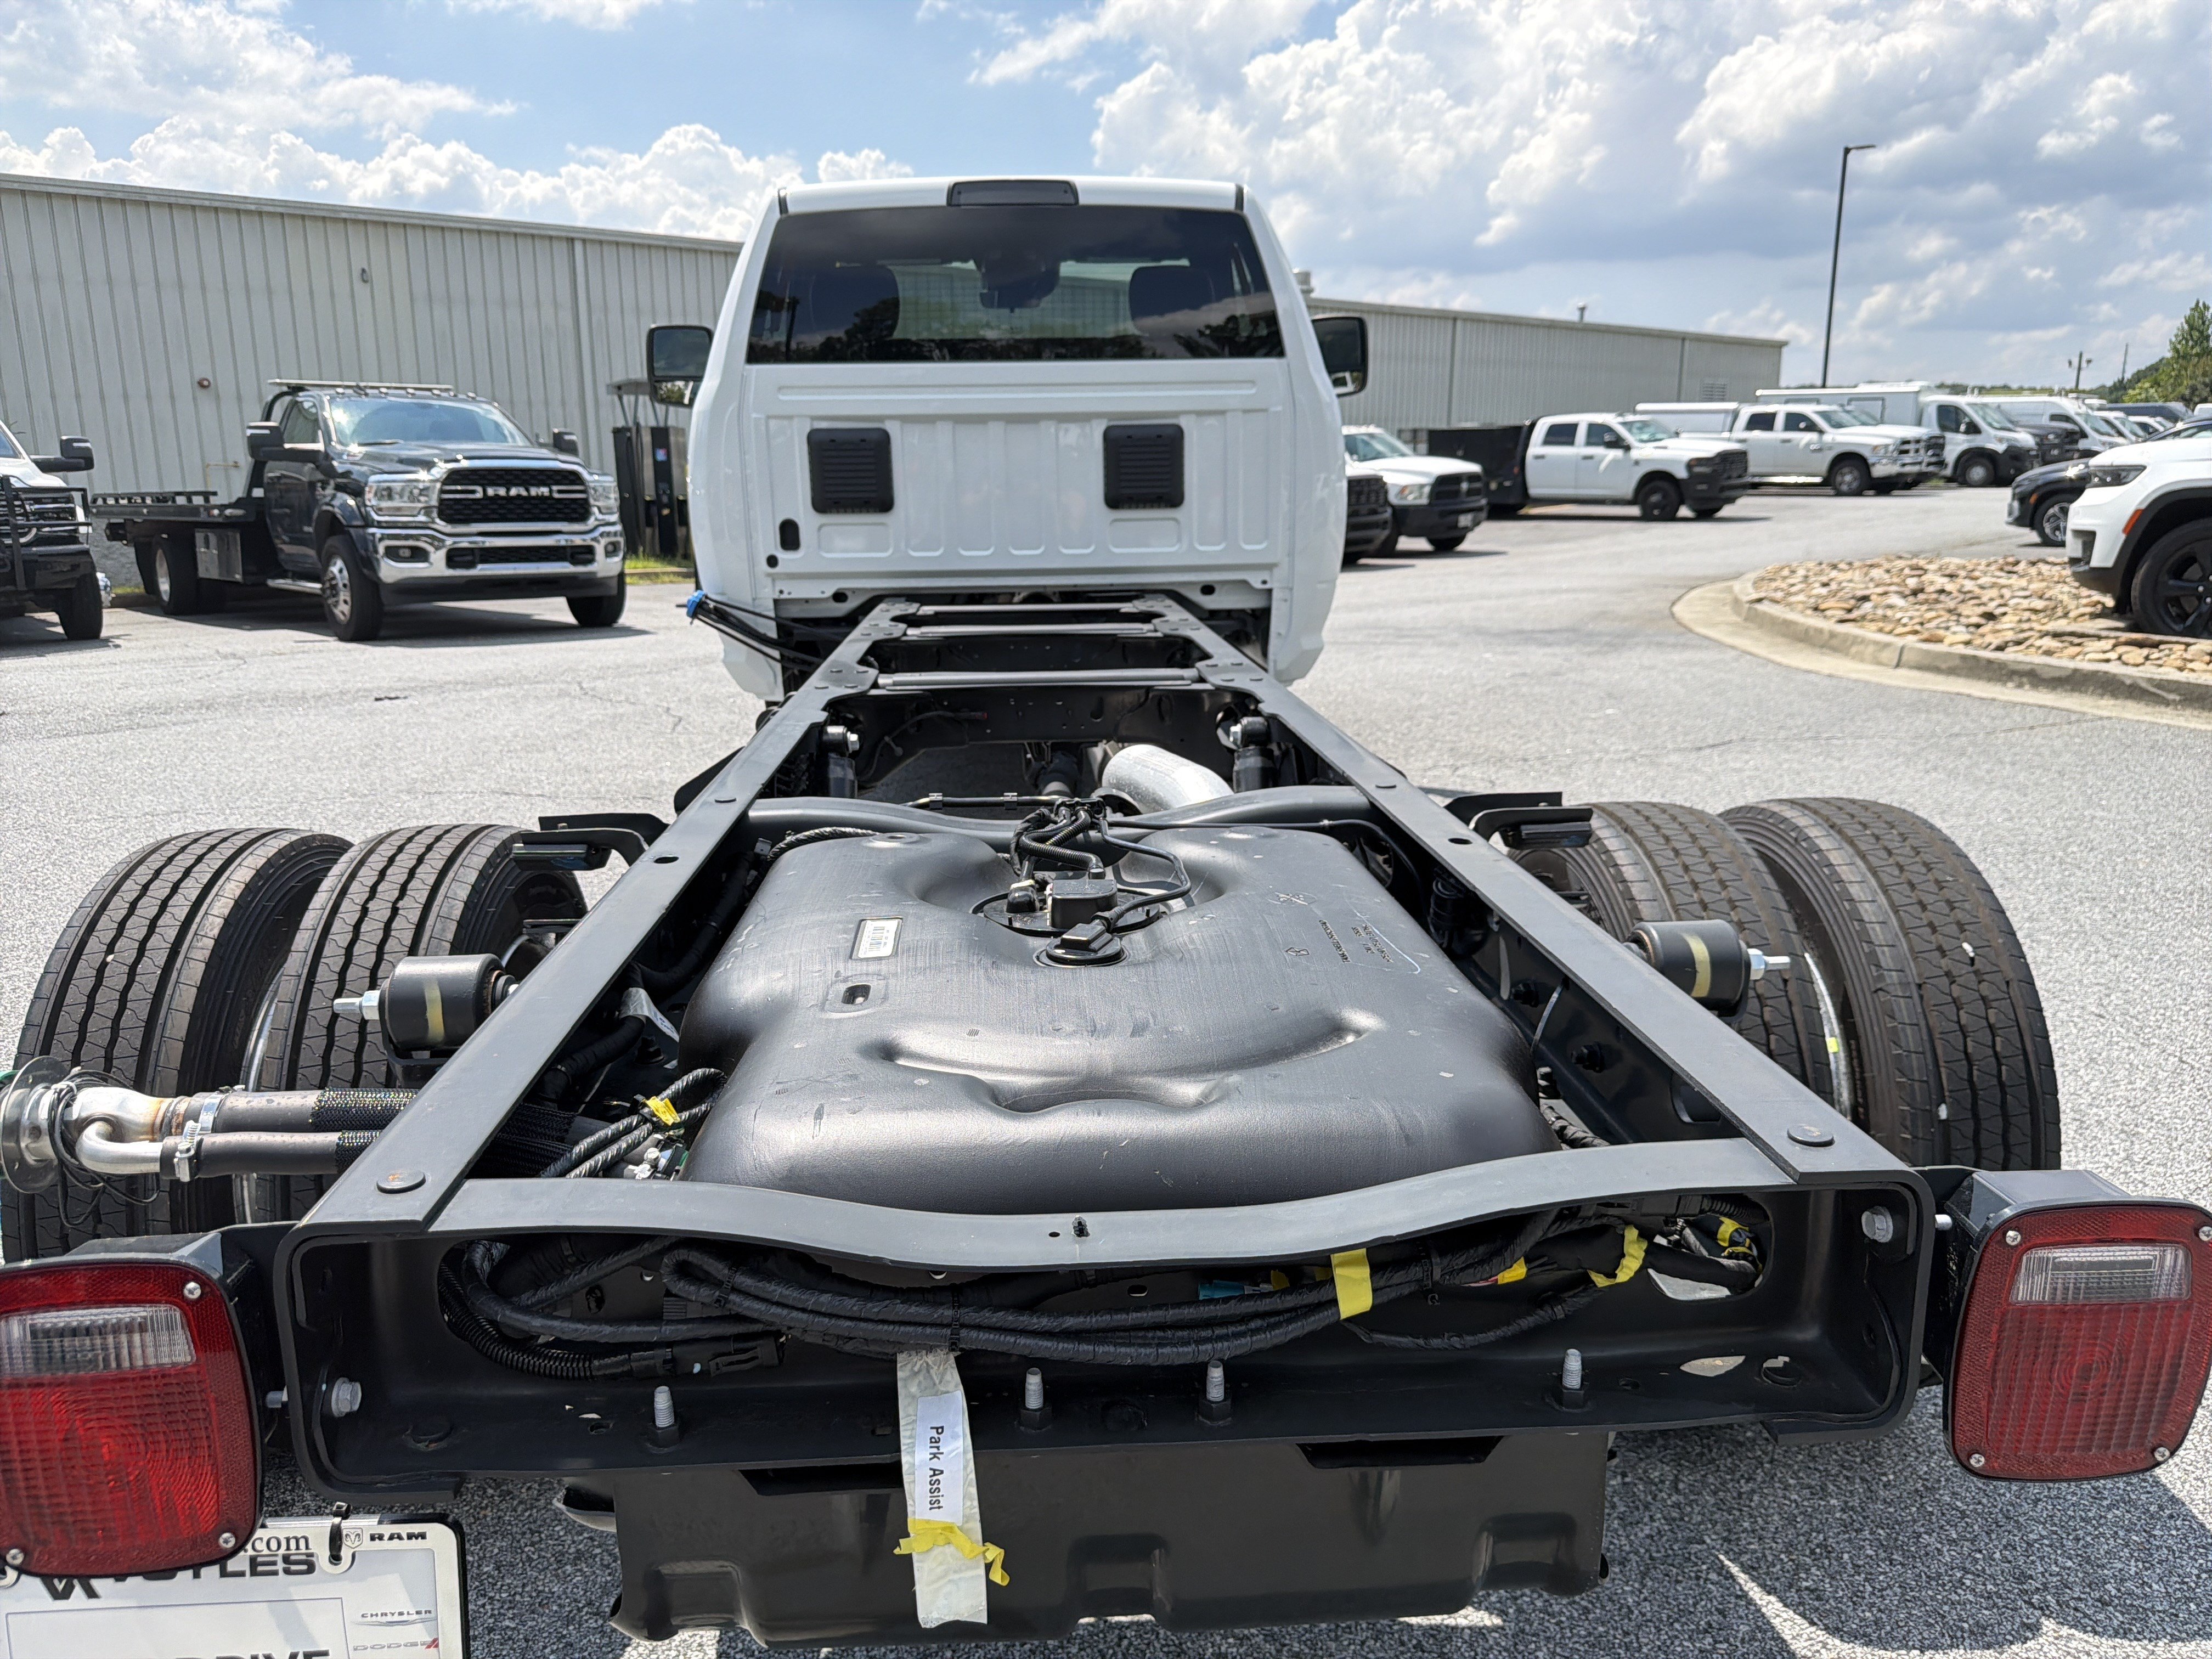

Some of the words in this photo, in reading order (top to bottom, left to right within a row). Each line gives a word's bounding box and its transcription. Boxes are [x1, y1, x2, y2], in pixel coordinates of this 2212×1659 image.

[486, 486, 550, 496] RAM
[929, 1425, 944, 1461] Park
[929, 1467, 944, 1511] Assist
[370, 1531, 427, 1542] RAM
[361, 1610, 432, 1618] CHRYSLER
